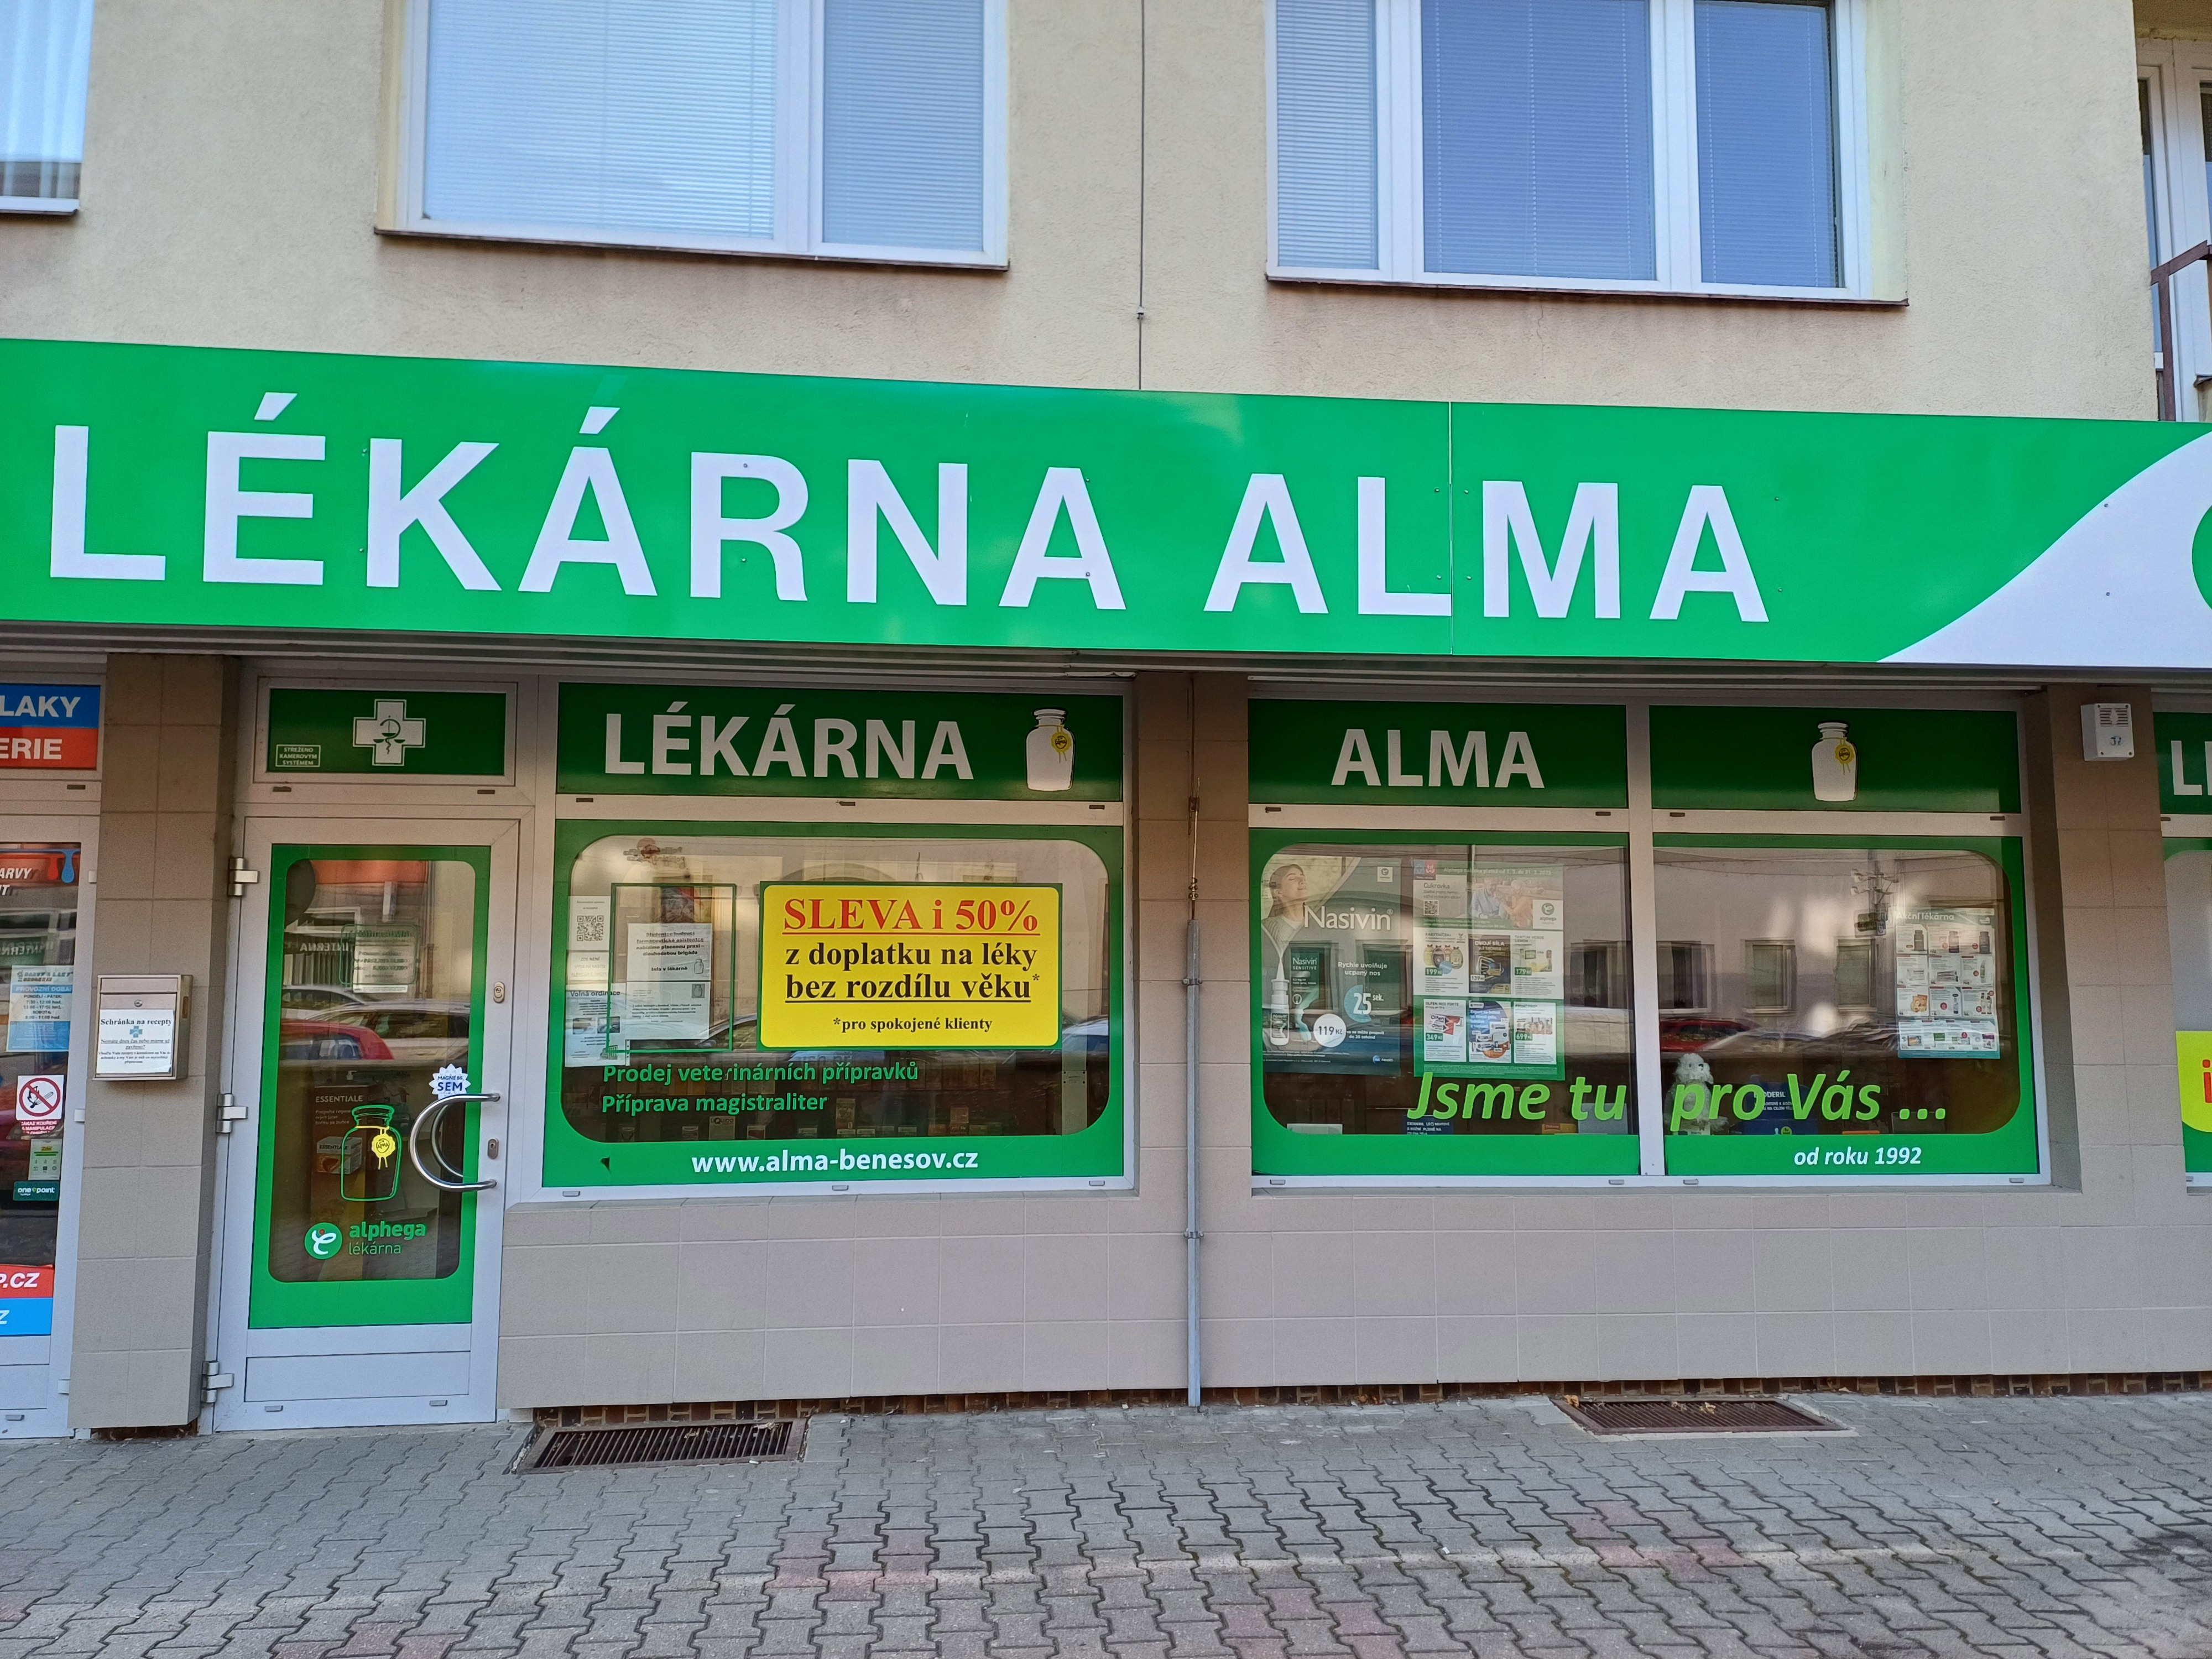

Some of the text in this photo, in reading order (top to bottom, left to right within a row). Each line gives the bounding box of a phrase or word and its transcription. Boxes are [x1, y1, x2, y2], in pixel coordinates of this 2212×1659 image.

[50, 392, 1769, 623] LÉKÁRNA ALMA
[605, 701, 974, 780] LÉKÁRNA
[1331, 729, 1545, 789] ALMA
[2171, 740, 2212, 796] L
[784, 899, 1038, 931] SLEVA i 50%
[785, 942, 1038, 971] z doplatku na léky
[1338, 961, 1387, 969] Rychle uvolňuje
[785, 974, 836, 999] bez
[847, 973, 951, 999] rozdílu
[1353, 993, 1371, 1015] 25
[870, 1016, 941, 1033] spokojené
[945, 1017, 993, 1033] klienty
[1318, 1026, 1334, 1035] 119
[603, 1061, 919, 1086] Prodej veterinárních přípravků
[437, 1082, 463, 1092] SEM
[1407, 1072, 1627, 1120] Jsme tu
[602, 1093, 828, 1117] Příprava magistraliter
[1670, 1083, 1765, 1132] pro
[1787, 1070, 1881, 1120] Vás
[691, 1148, 978, 1173] www.alma-benesov.cz
[1794, 1146, 1922, 1165] od roku 1992
[349, 1220, 426, 1241] alphega
[348, 1241, 402, 1255] lékárna
